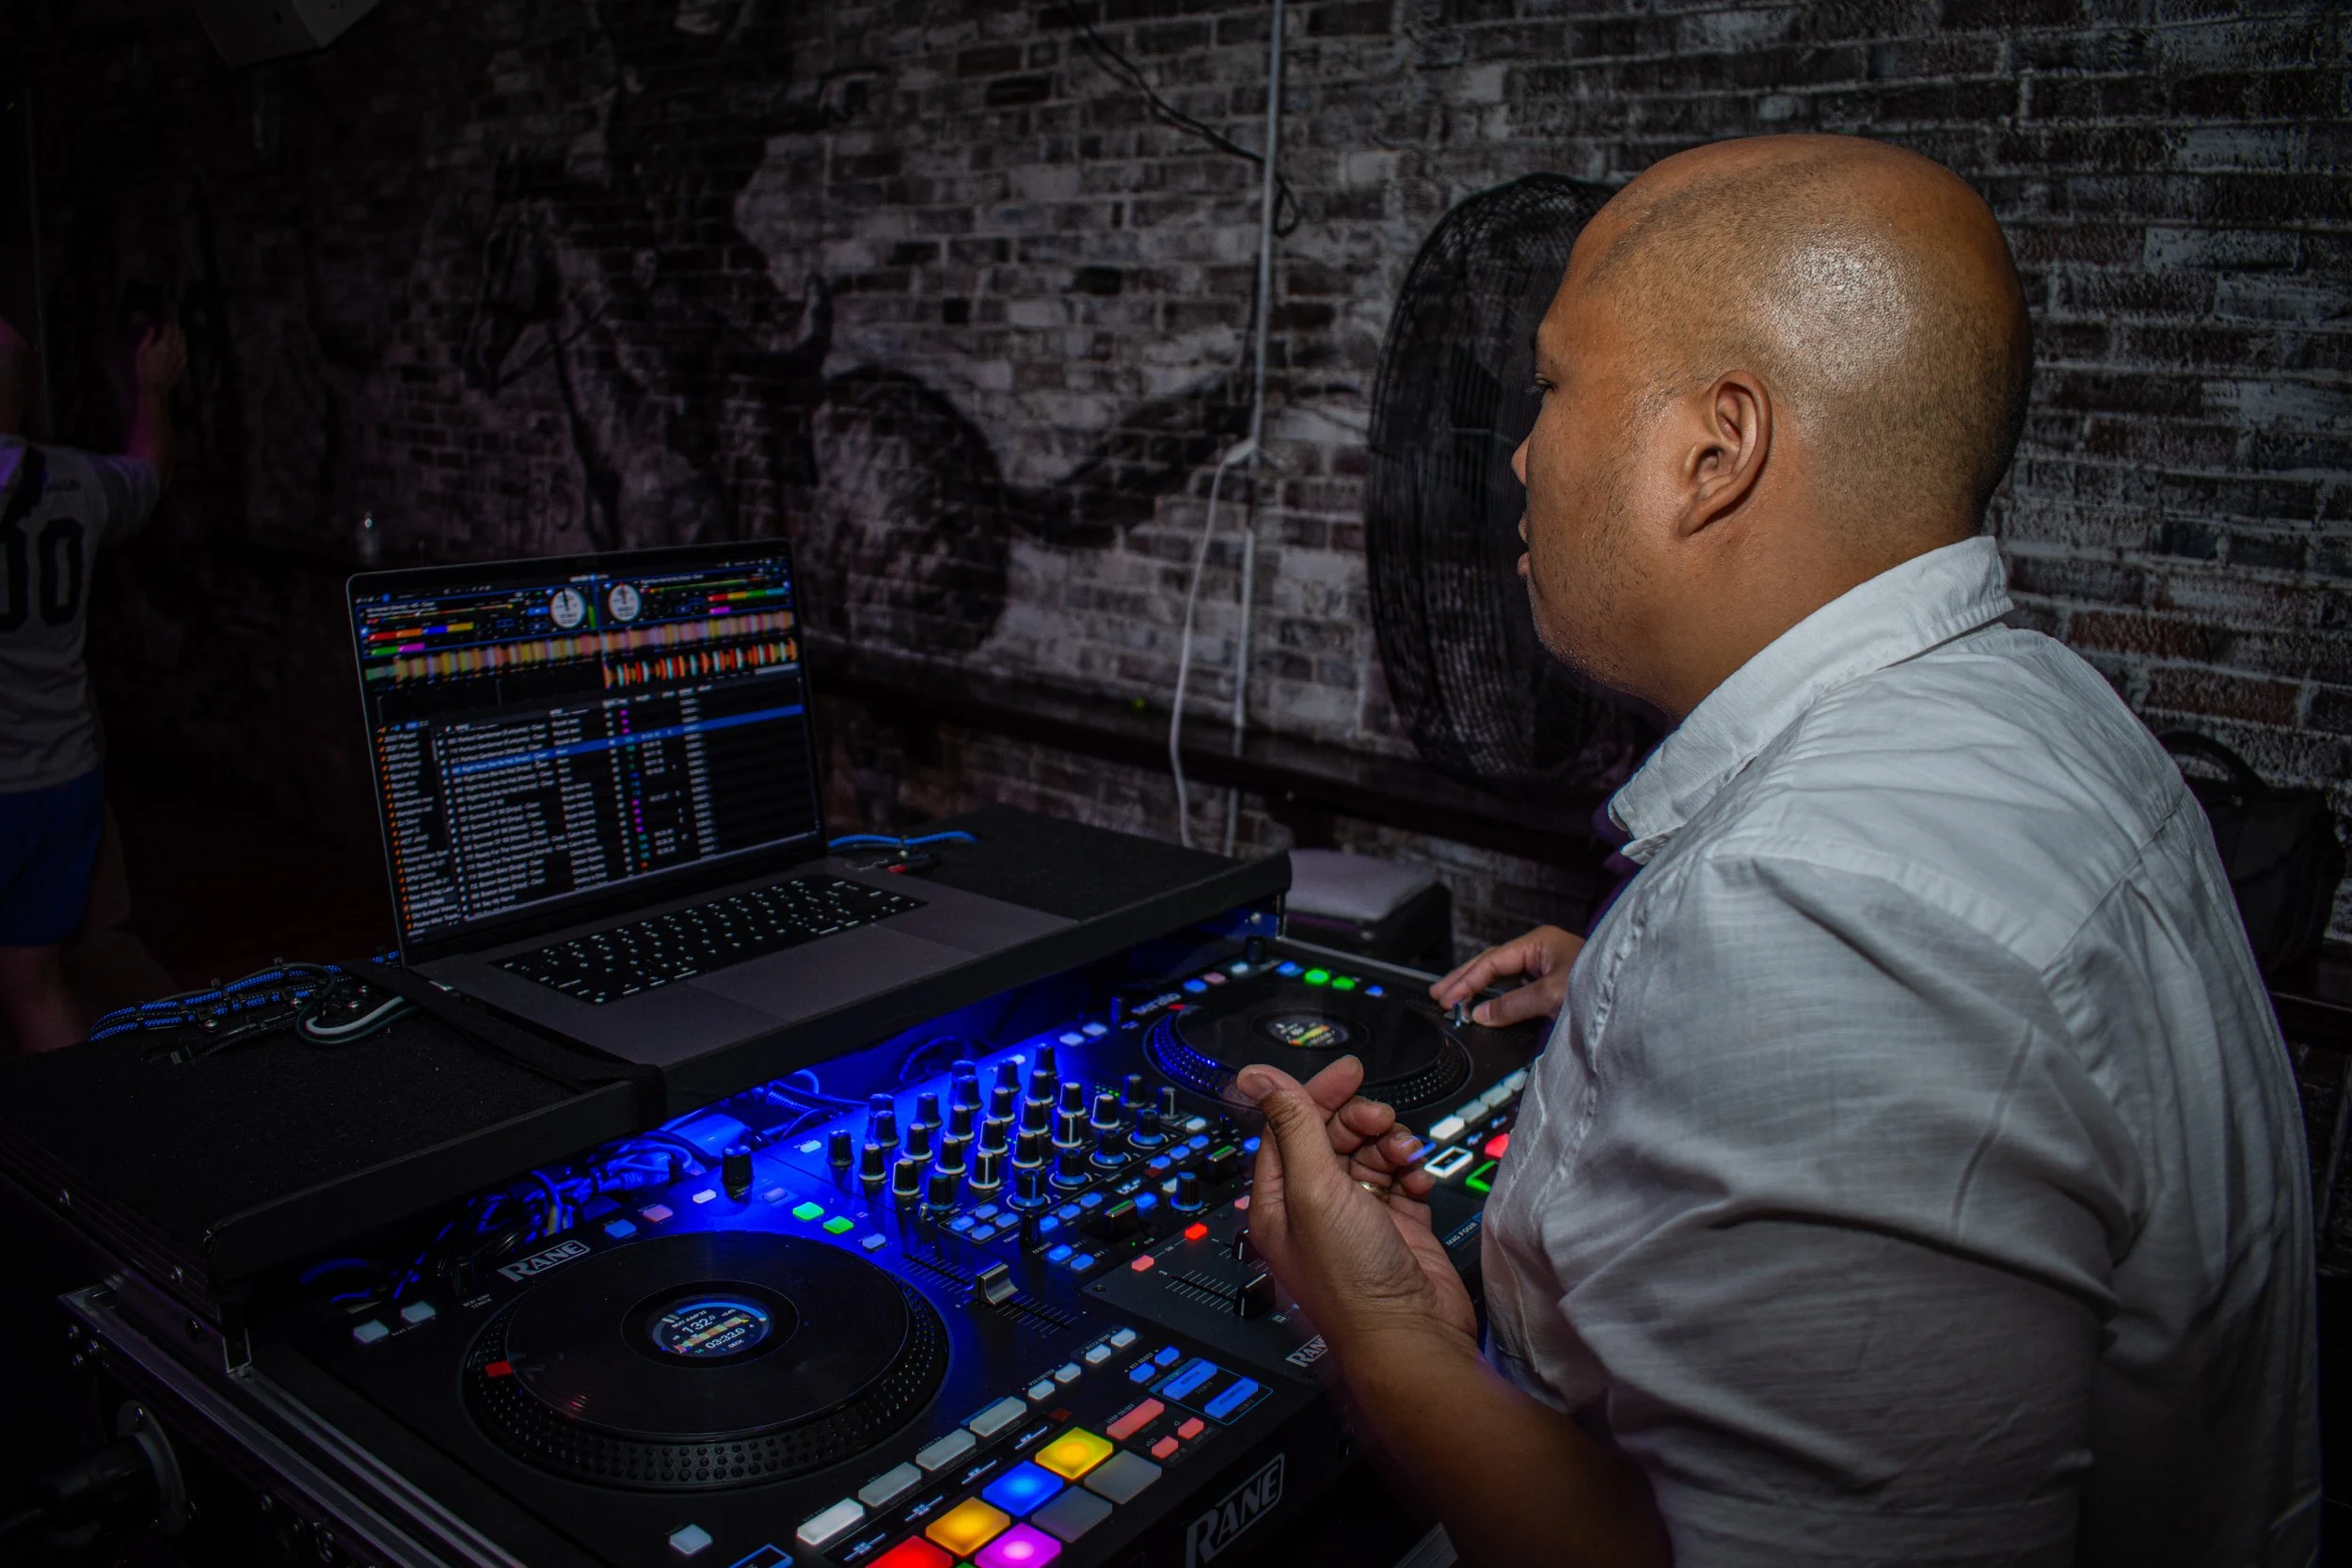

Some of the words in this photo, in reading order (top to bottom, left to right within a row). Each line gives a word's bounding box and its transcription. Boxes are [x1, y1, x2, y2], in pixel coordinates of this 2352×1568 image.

[1458, 1221, 1478, 1236] FOUR
[497, 1239, 591, 1282] RANE
[728, 1339, 745, 1348] DECK
[1184, 1452, 1286, 1568] RANE
